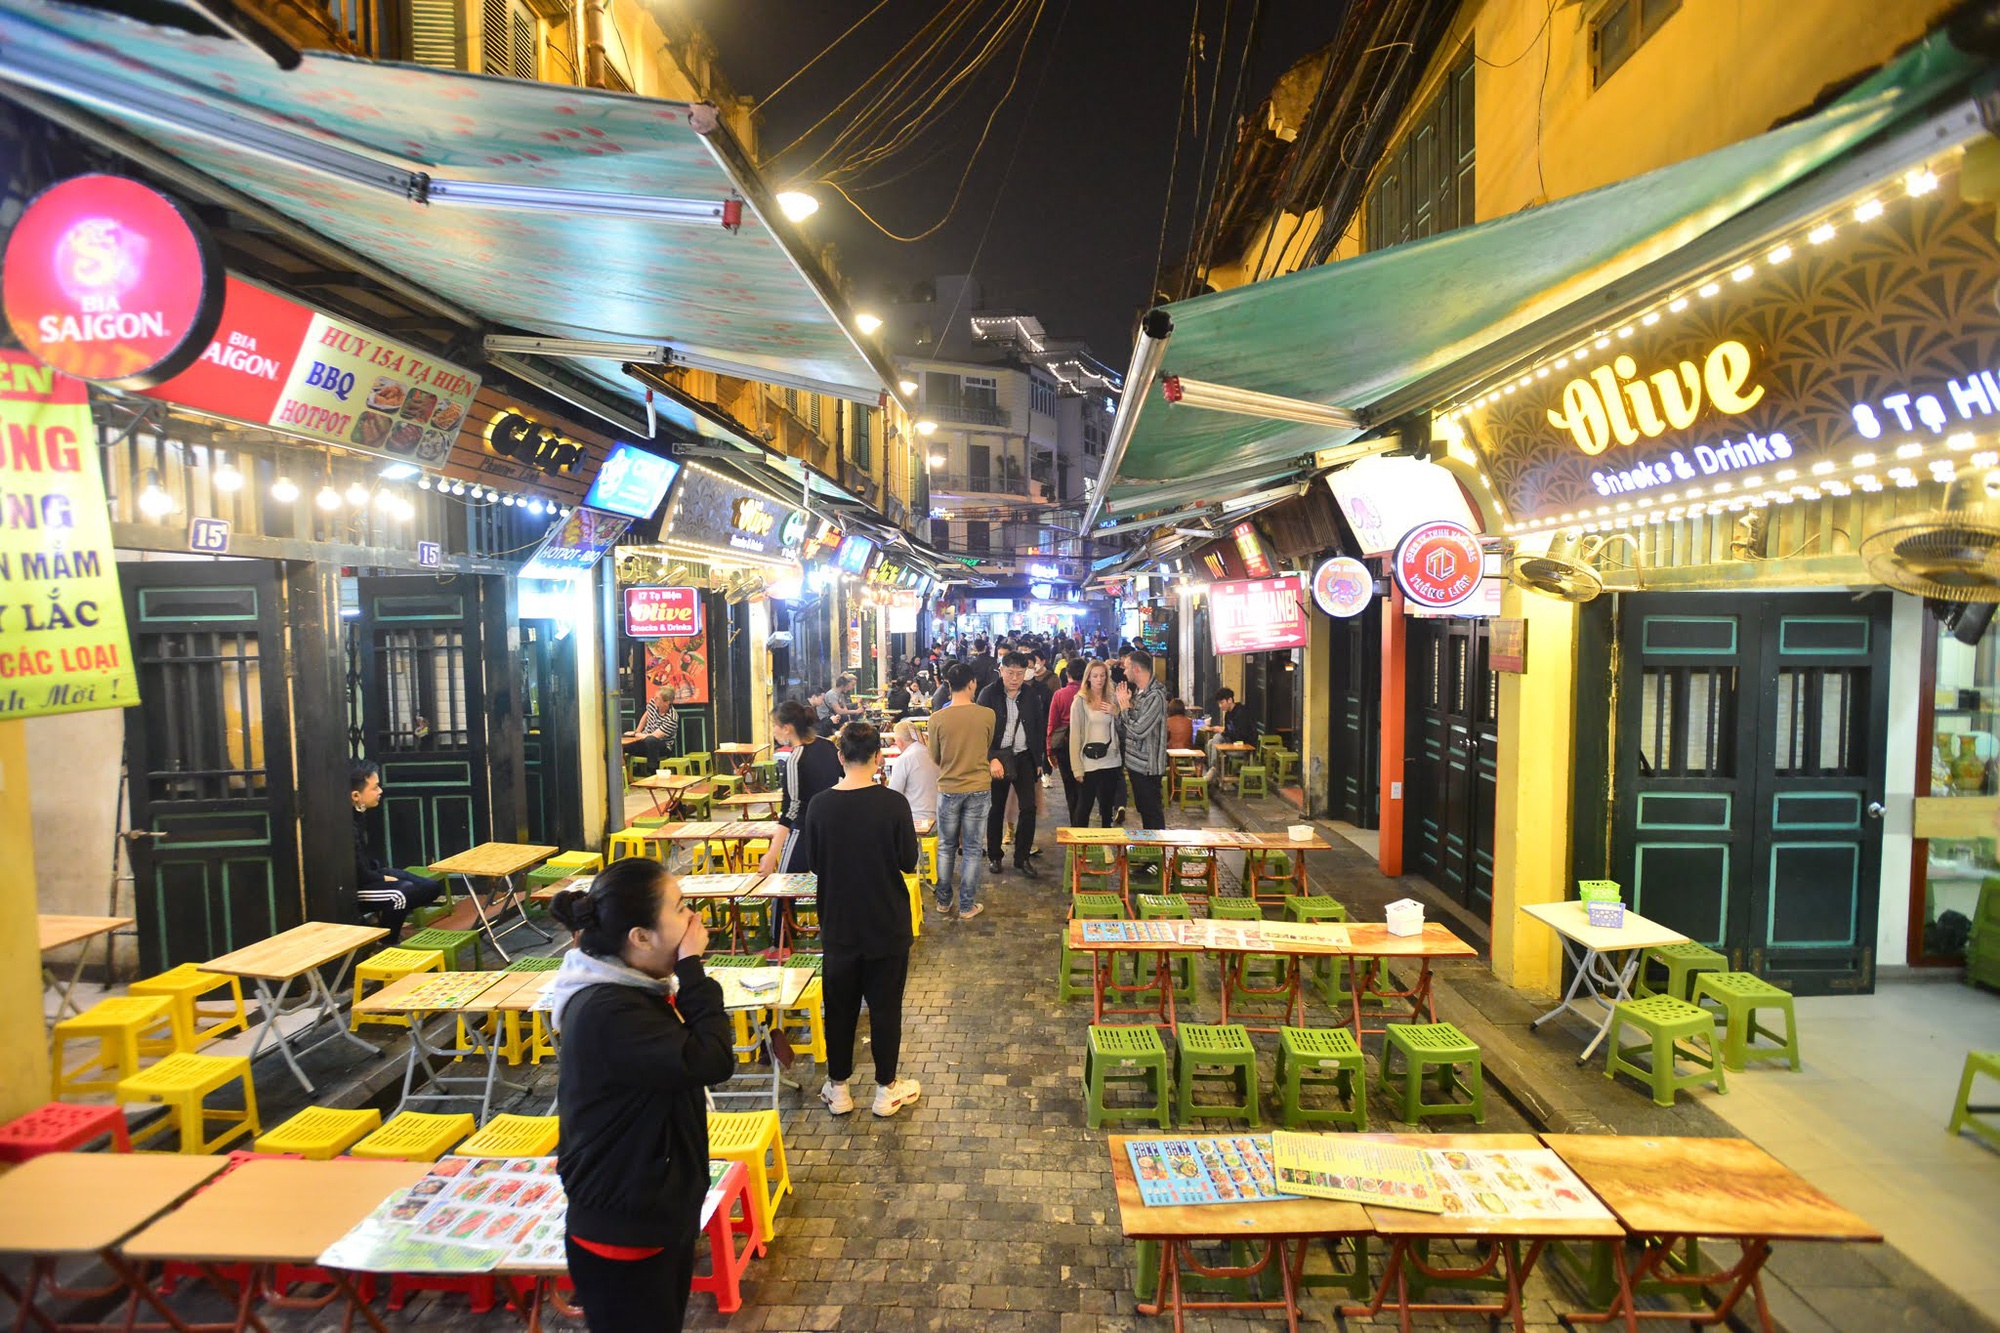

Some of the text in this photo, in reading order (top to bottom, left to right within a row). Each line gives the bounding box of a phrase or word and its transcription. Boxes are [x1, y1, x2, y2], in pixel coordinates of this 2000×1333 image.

[81, 296, 121, 312] BIA
[39, 311, 164, 343] SAIGON
[229, 331, 256, 351] BIA
[202, 341, 280, 380] AIGON
[319, 326, 475, 398] HUY 15A TẠ HIỆN
[306, 360, 355, 401] BBQ
[1547, 340, 1765, 456] Olive
[280, 400, 351, 437] HOTPOT
[1852, 403, 1881, 439] 8
[1592, 431, 1793, 497] Snacks & Drinks
[540, 546, 578, 561] HOTPOT
[22, 586, 99, 631] LẮC
[629, 602, 693, 622] Olive
[60, 643, 119, 675] LOẠI
